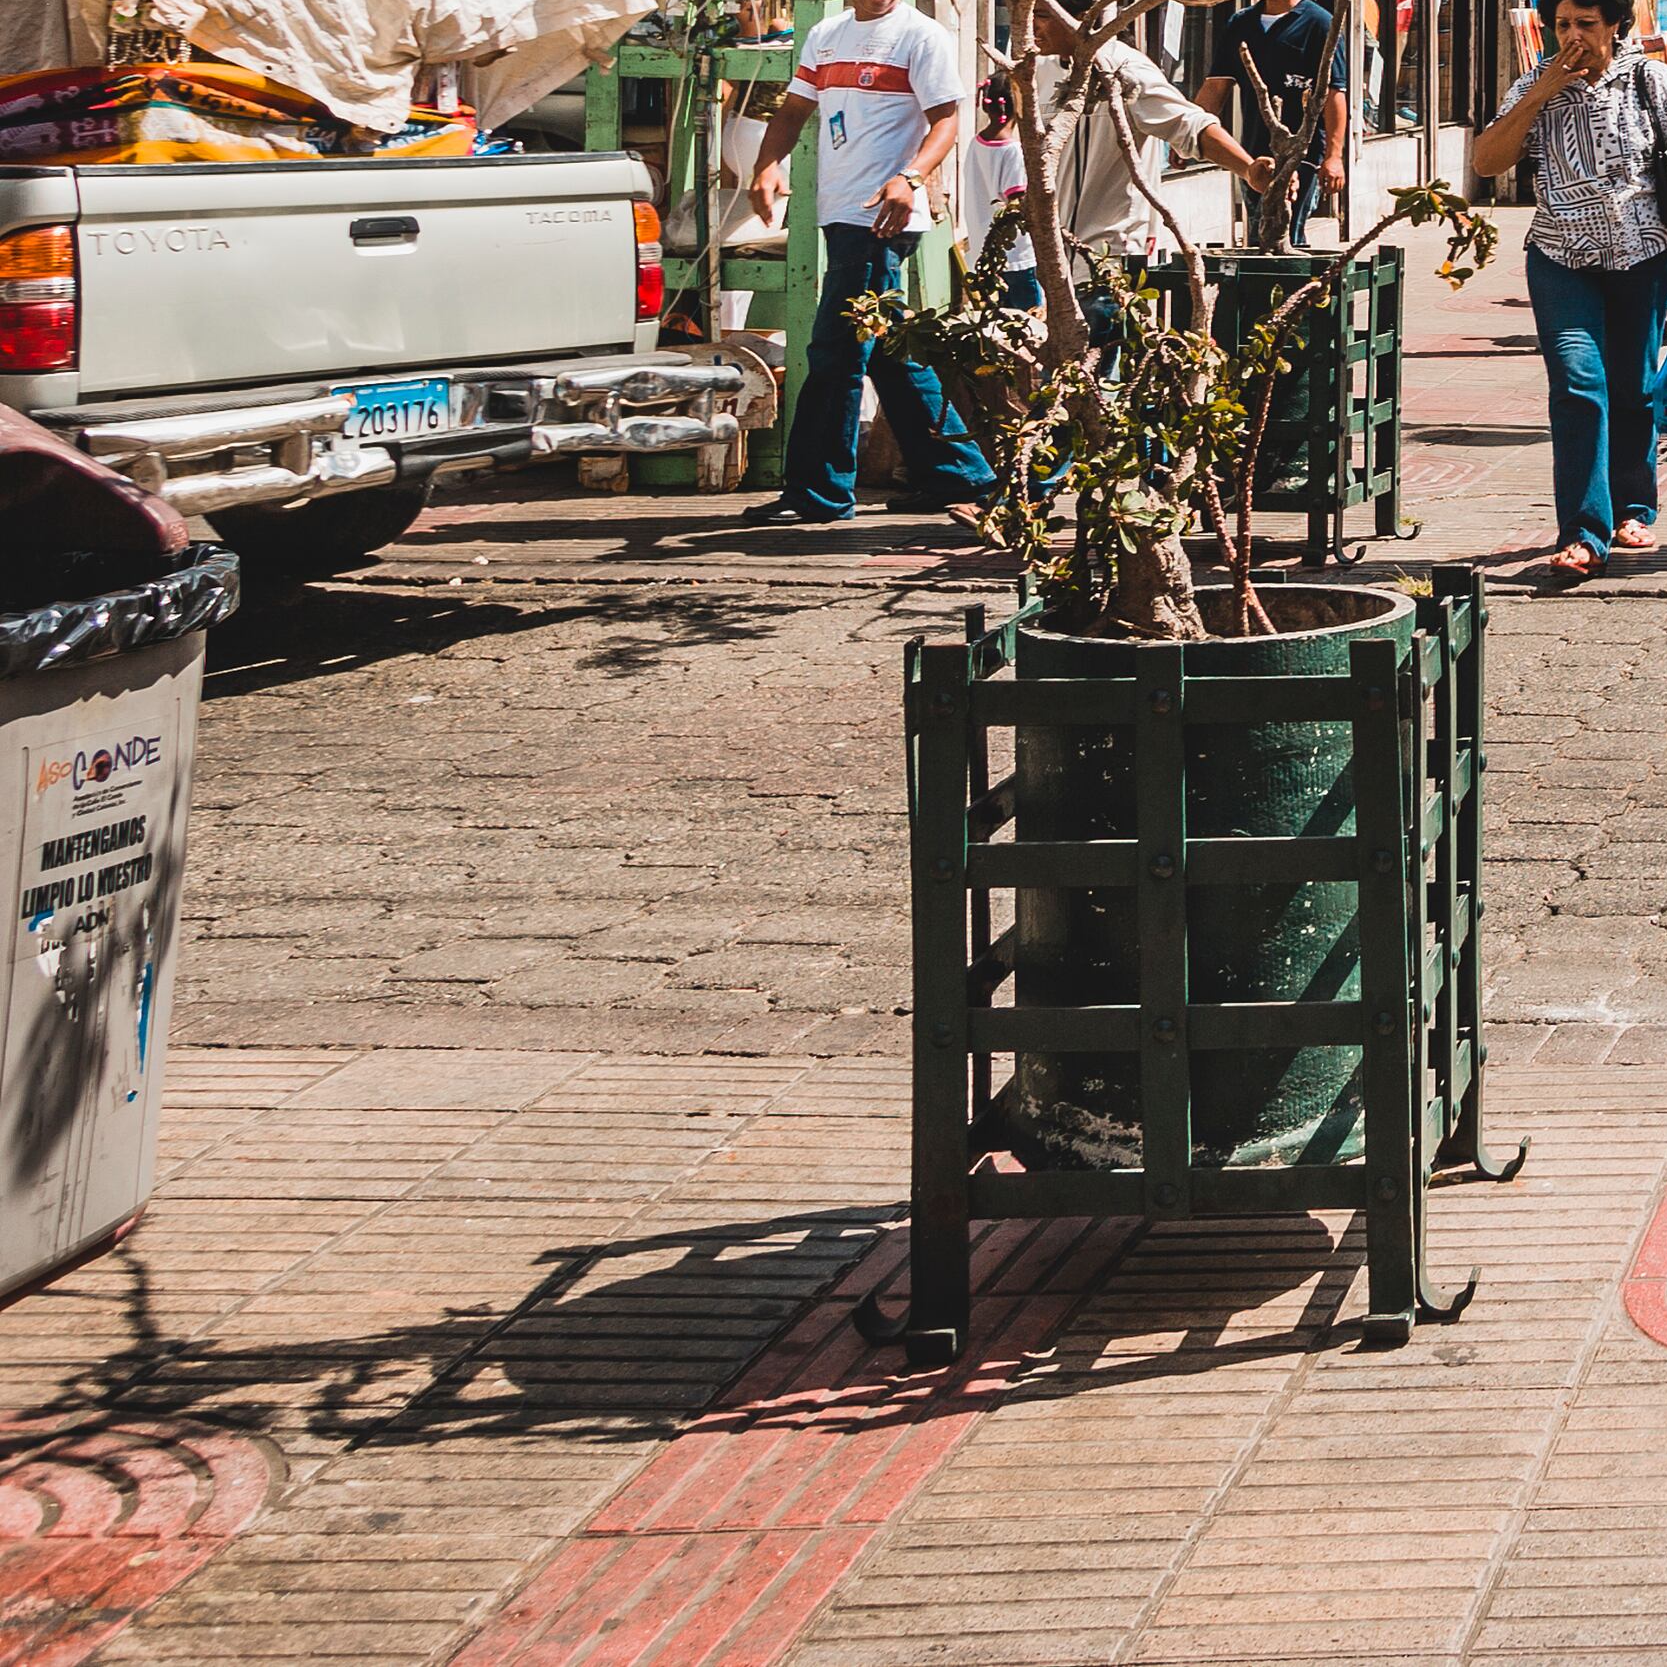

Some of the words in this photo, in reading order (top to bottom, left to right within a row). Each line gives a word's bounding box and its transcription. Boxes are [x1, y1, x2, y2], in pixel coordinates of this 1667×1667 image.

[525, 208, 612, 225] TACOMA
[88, 226, 231, 256] TOYOTA
[41, 815, 146, 871] MANTENGAMOS
[21, 877, 75, 919] LIMPIO
[78, 872, 94, 903] LO
[97, 853, 153, 898] NUESTRO
[74, 908, 110, 935] ADN
